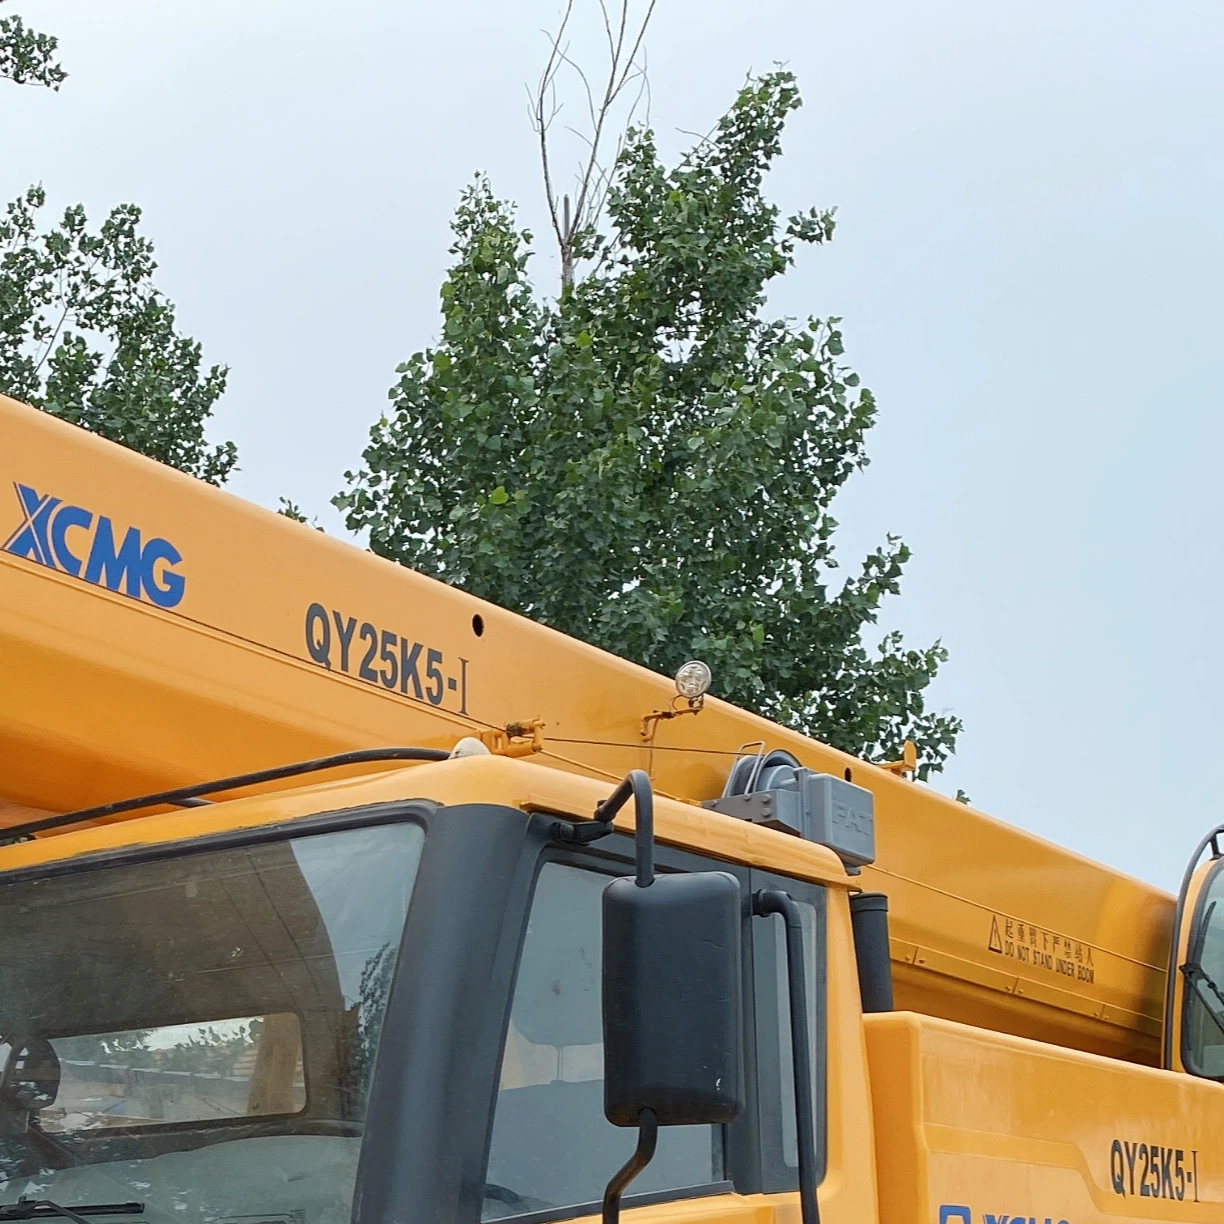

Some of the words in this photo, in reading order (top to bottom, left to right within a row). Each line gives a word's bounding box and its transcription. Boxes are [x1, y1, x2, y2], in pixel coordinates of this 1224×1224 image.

[3, 481, 186, 608] XCMG
[1005, 940, 1015, 958] DO
[1017, 945, 1030, 963] NOT
[1033, 950, 1053, 970] STAND
[1056, 958, 1075, 978] UNDER
